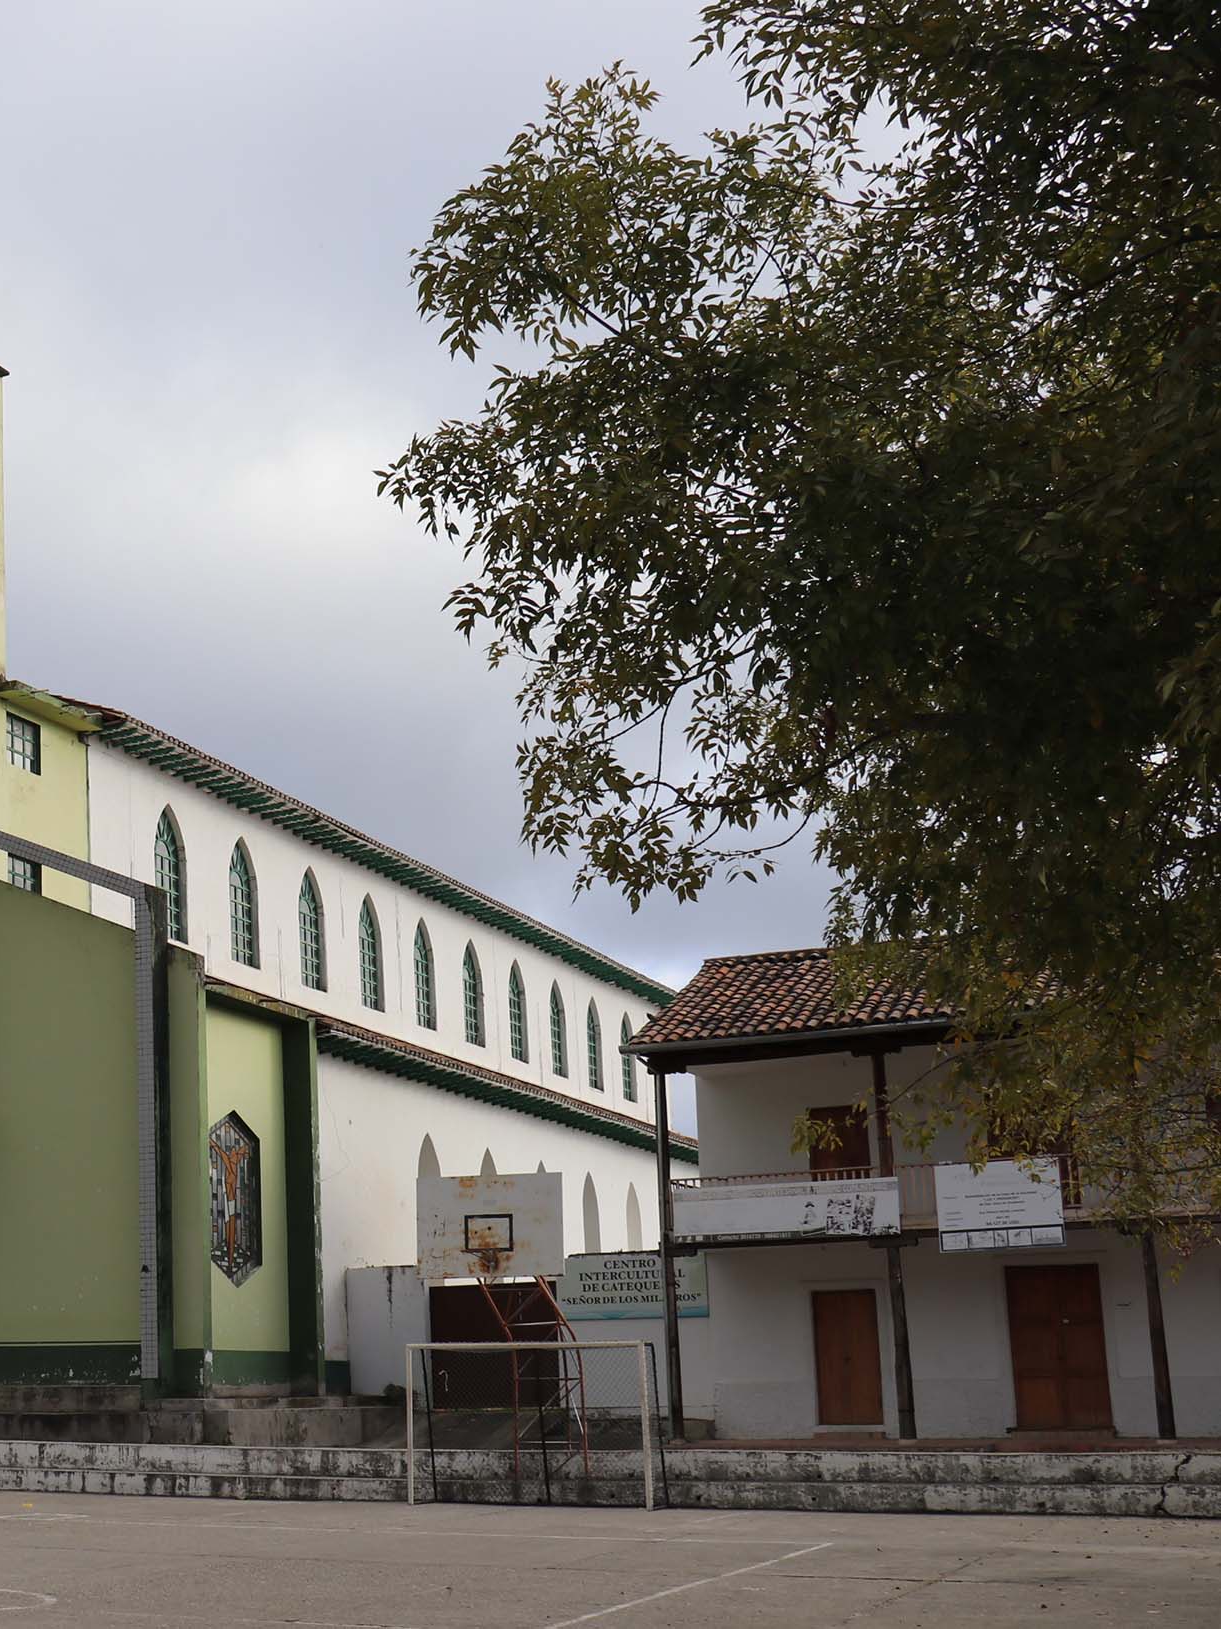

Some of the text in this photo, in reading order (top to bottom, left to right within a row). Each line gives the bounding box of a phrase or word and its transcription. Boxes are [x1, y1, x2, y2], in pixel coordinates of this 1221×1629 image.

[604, 1258, 656, 1270] CENTRO
[579, 1269, 685, 1281] INTERCULTUL
[582, 1280, 681, 1292] DE CATEQUES
[602, 1295, 617, 1304] DE
[619, 1295, 639, 1304] LOS
